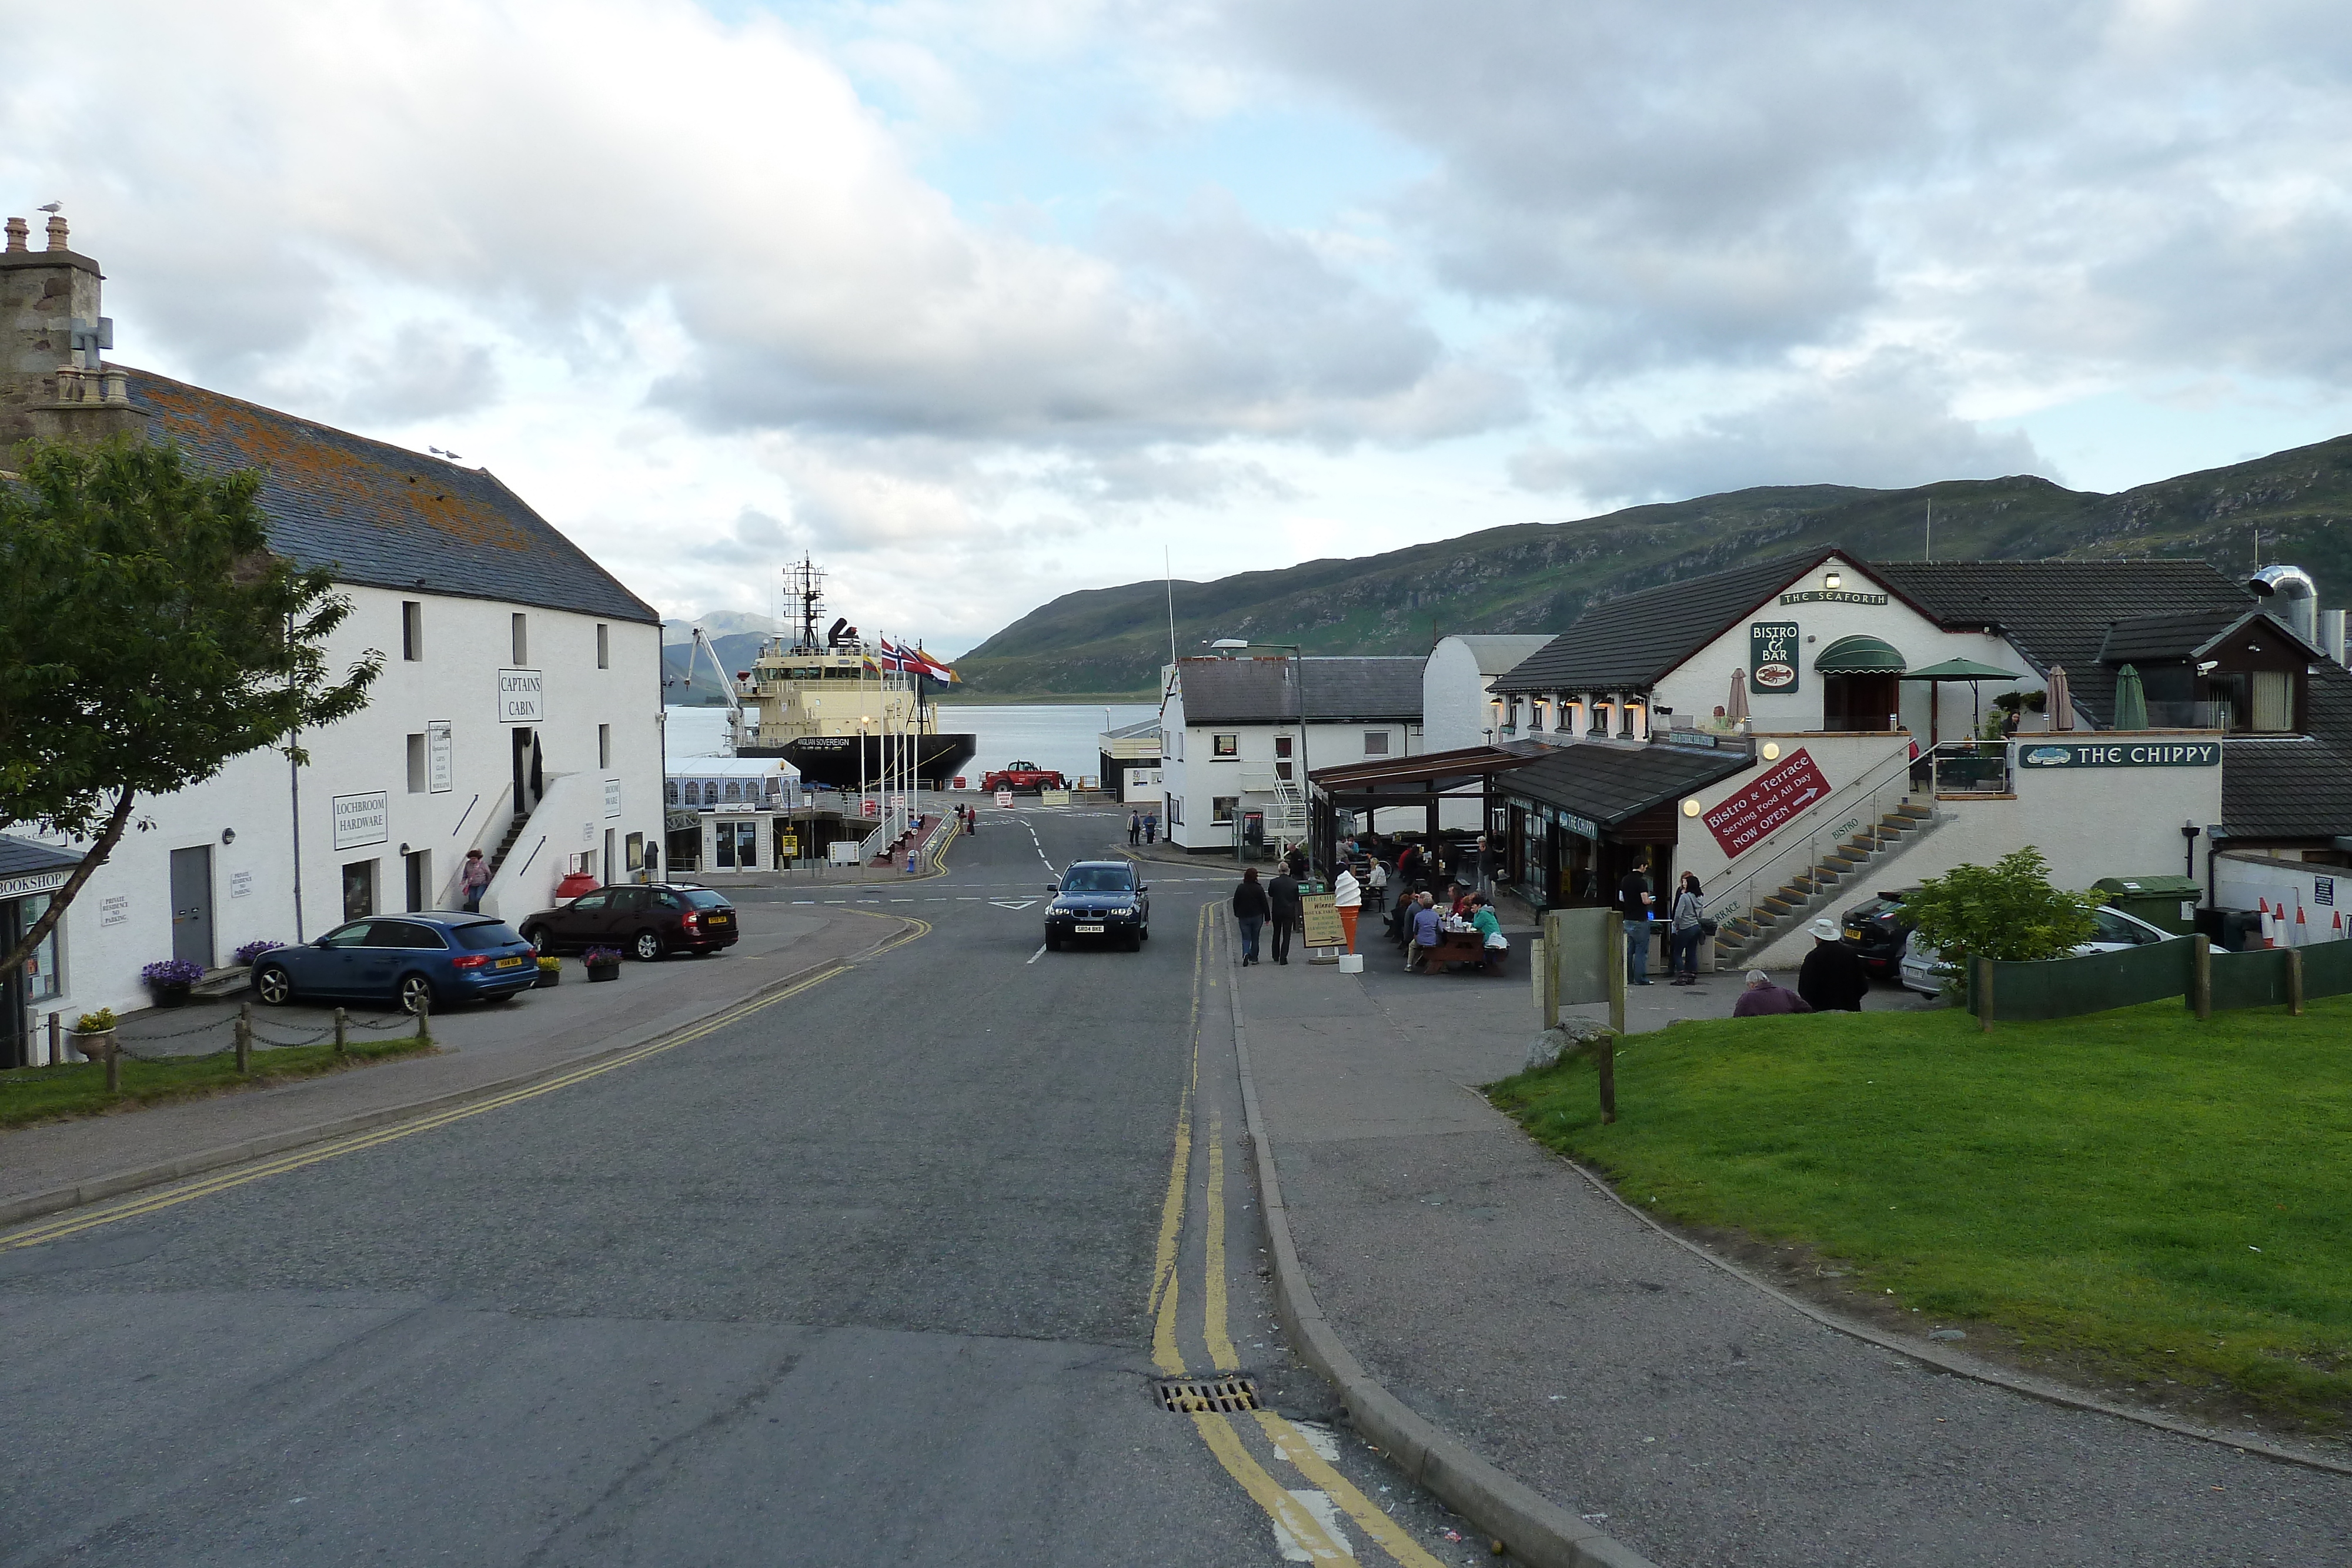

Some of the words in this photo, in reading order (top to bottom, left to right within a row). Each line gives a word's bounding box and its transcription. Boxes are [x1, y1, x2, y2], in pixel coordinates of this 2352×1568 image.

[1785, 593, 1809, 603] THE
[1819, 592, 1885, 604] SEAFORTH
[1753, 627, 1797, 638] BISTRO
[1768, 635, 1783, 653] &
[1762, 650, 1788, 661] BAR
[509, 701, 534, 716] CABIN
[2077, 747, 2122, 763] THE
[2130, 746, 2213, 763] CHIPPY
[1708, 799, 1747, 828] Bistro
[1750, 791, 1760, 800] &
[1760, 757, 1809, 792] Terrace
[337, 798, 384, 815] LOCHBROOM
[1722, 811, 1758, 836] Serving
[1756, 794, 1779, 813] Food
[1780, 785, 1793, 797] All
[1794, 773, 1811, 788] Day
[340, 815, 383, 831] HARDWARE
[1568, 814, 1577, 830] THE
[1578, 818, 1595, 837] CHIPPY
[1732, 827, 1758, 848] NOW
[1760, 805, 1790, 829] OPEN
[1832, 818, 1858, 840] BISTRO
[102, 902, 128, 911] RESIDENCE
[106, 896, 125, 905] PRIVATE
[105, 914, 127, 924] PARKING
[1722, 917, 1739, 932] BAR
